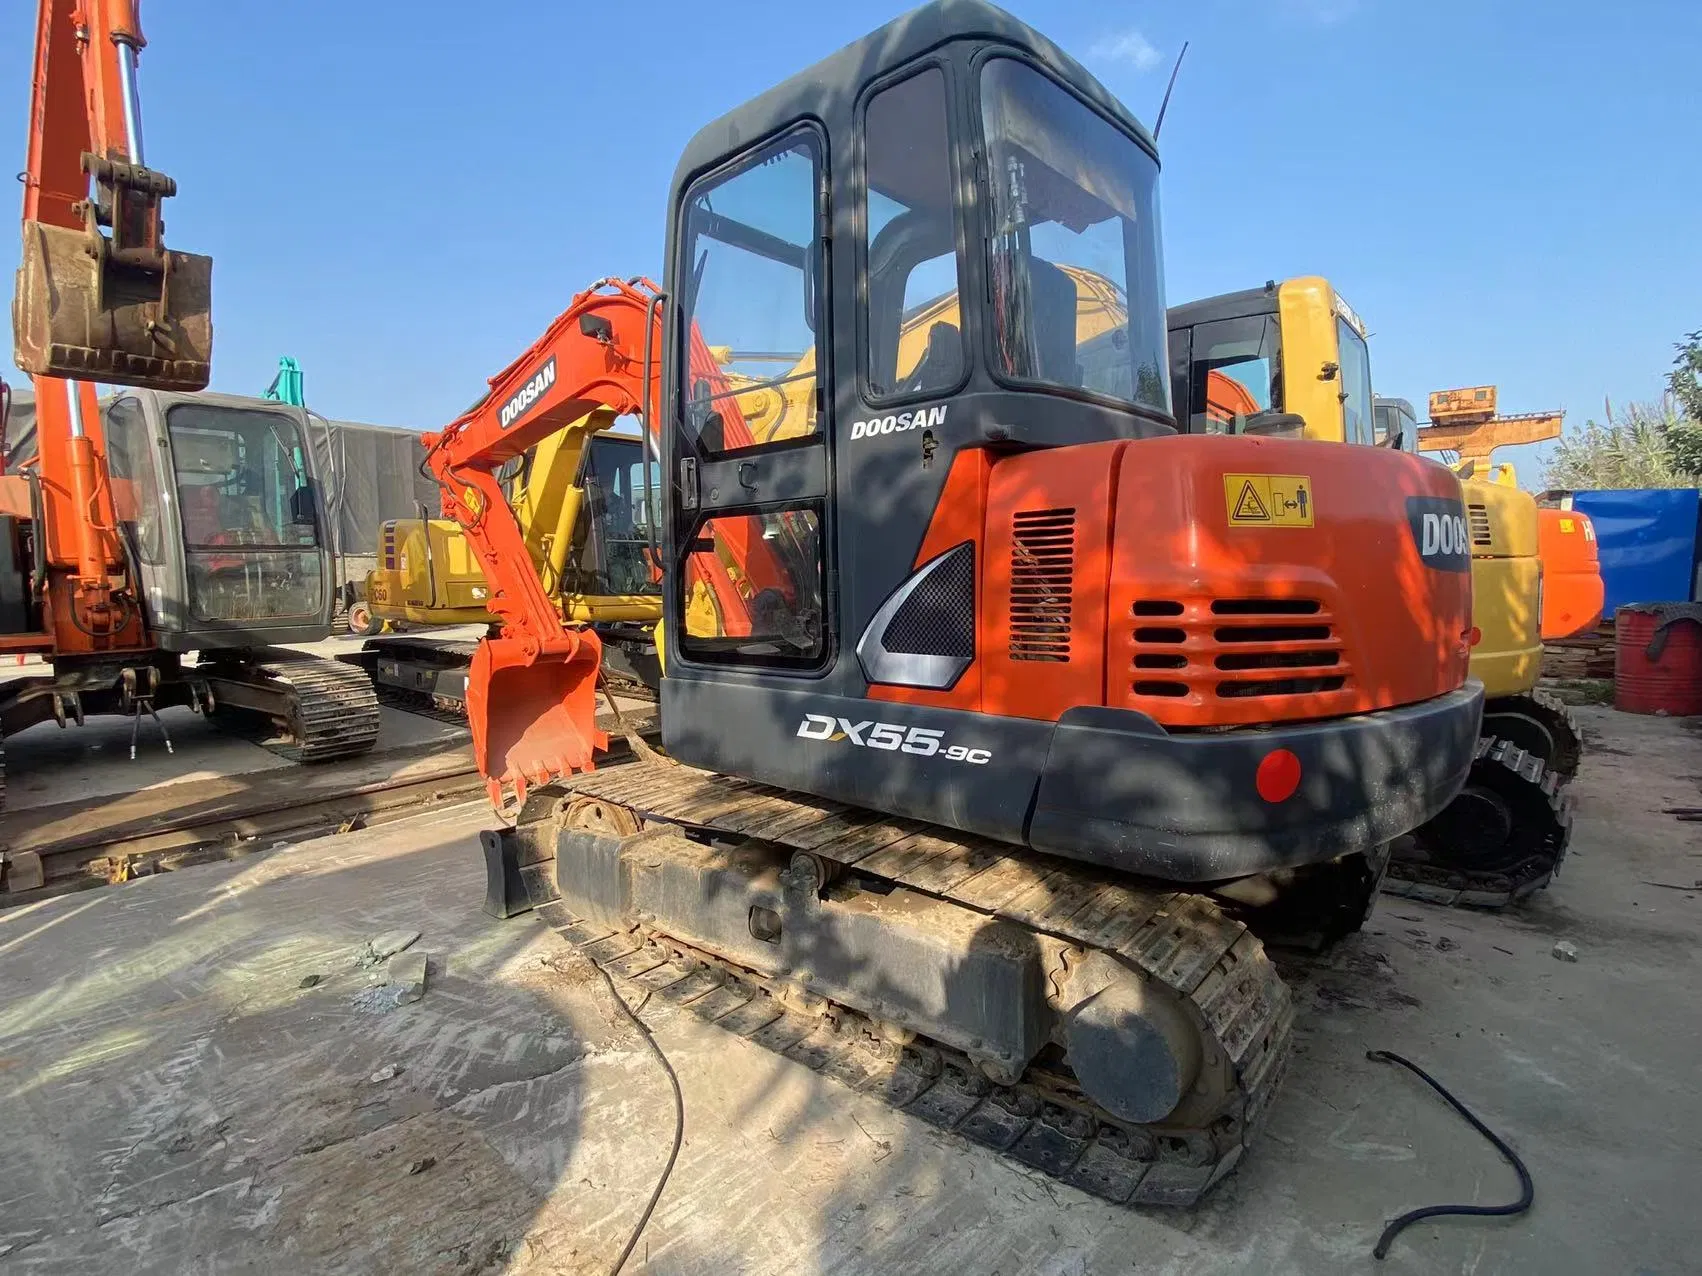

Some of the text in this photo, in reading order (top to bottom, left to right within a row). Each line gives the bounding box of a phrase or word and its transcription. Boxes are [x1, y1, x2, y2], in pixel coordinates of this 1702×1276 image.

[501, 360, 555, 428] DOOSAN
[850, 405, 948, 440] DOOSAN
[796, 713, 992, 765] DX55-9C
